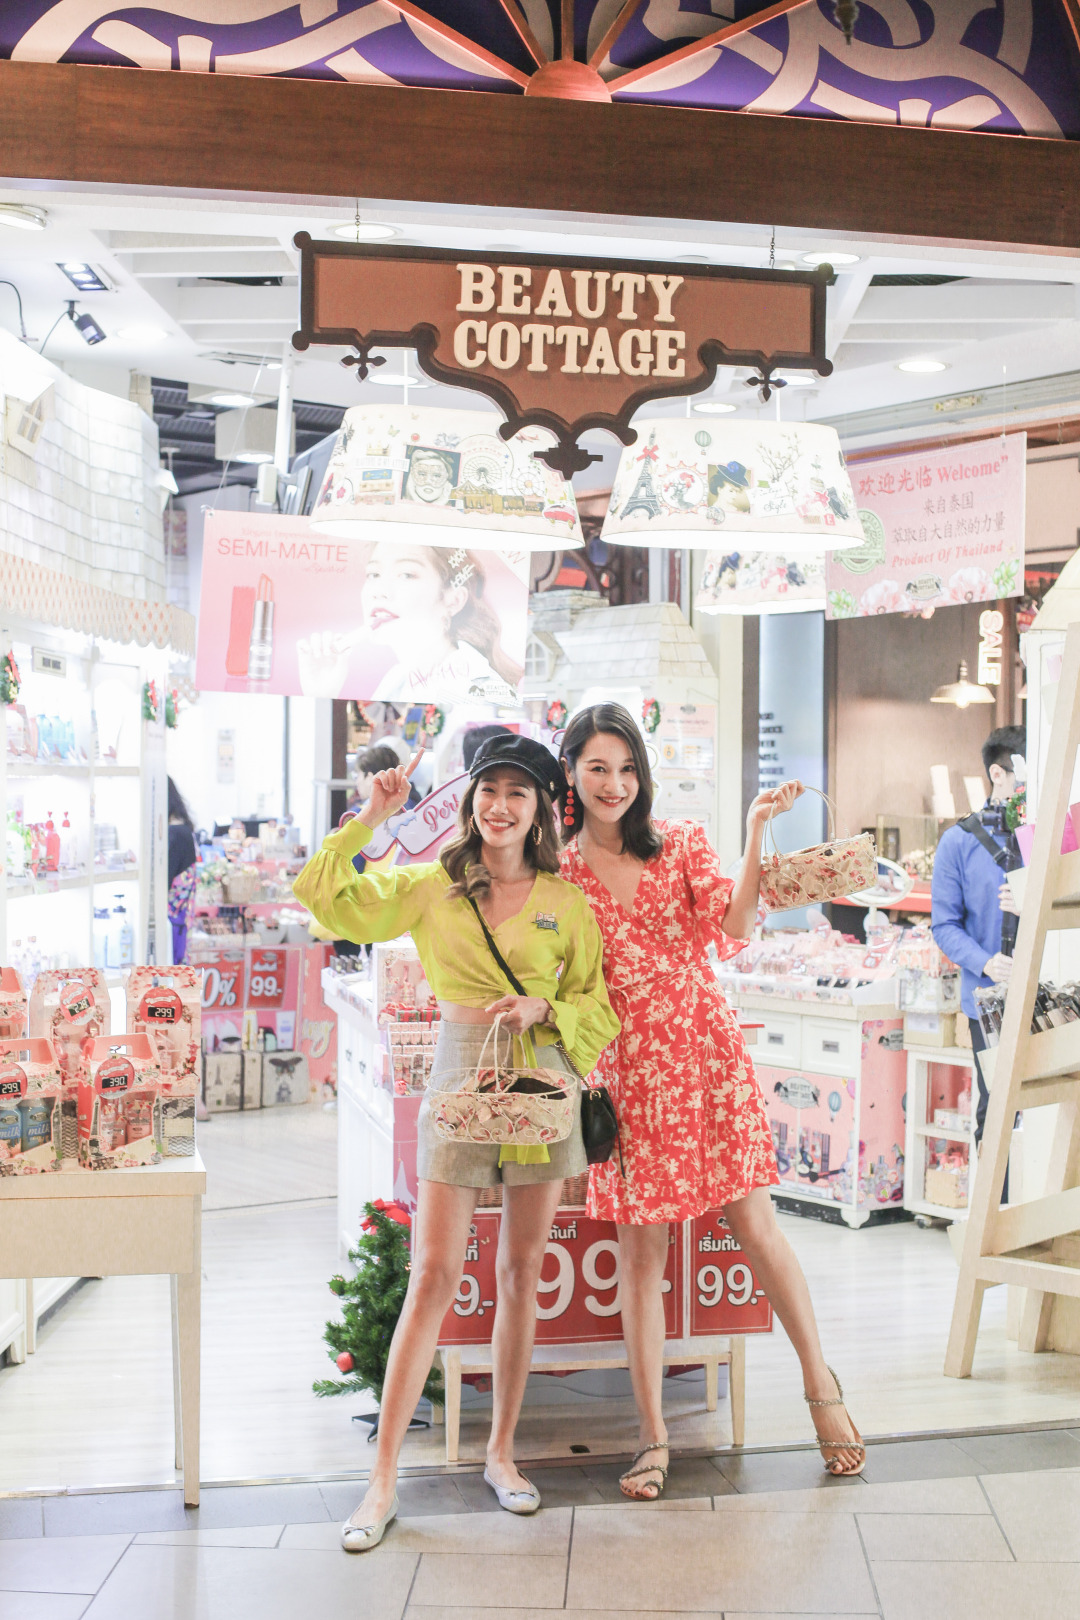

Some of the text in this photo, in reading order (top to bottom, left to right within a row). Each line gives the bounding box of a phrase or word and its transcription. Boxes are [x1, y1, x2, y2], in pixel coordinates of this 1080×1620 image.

[456, 263, 685, 322] BEAUTY
[453, 319, 686, 377] COTTAGE
[858, 465, 933, 497] 欢迎光临
[923, 490, 975, 517] 来自泰国
[217, 537, 349, 563] SEMI-MATTE
[891, 551, 935, 568] Product
[937, 546, 953, 564] Of
[955, 539, 1004, 559] Thailand
[978, 609, 1004, 686] SALE
[195, 967, 237, 1009] 0%
[250, 975, 283, 998] 99.-
[28, 1122, 50, 1136] milk
